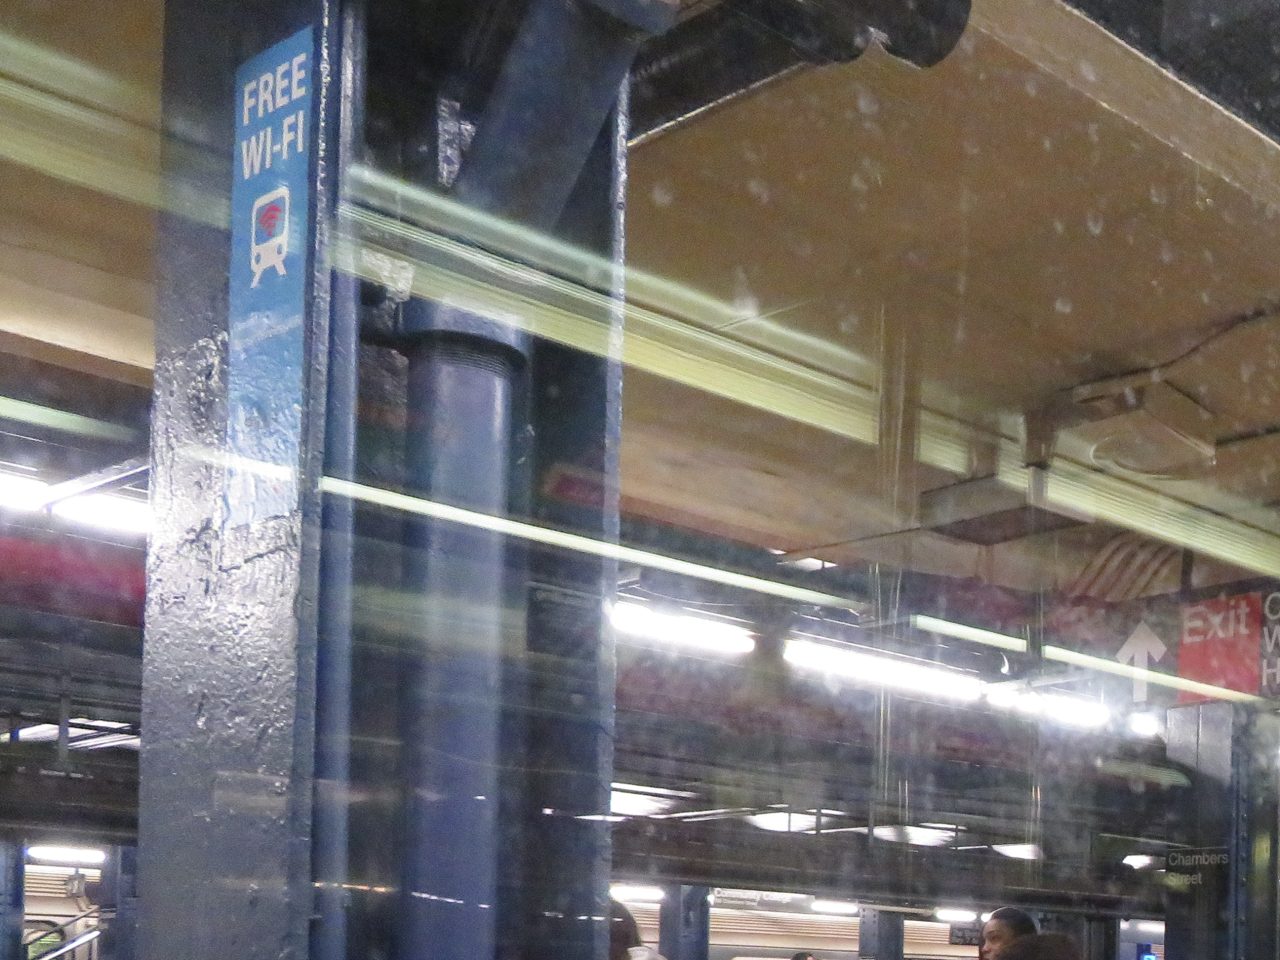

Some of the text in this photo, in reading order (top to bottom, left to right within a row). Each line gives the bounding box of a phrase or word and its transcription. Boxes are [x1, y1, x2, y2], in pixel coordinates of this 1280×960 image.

[243, 53, 307, 126] FREE
[241, 110, 305, 180] WI-FI
[1182, 599, 1251, 644] Exit
[1168, 852, 1229, 866] Chambers
[1168, 872, 1203, 885] Street
